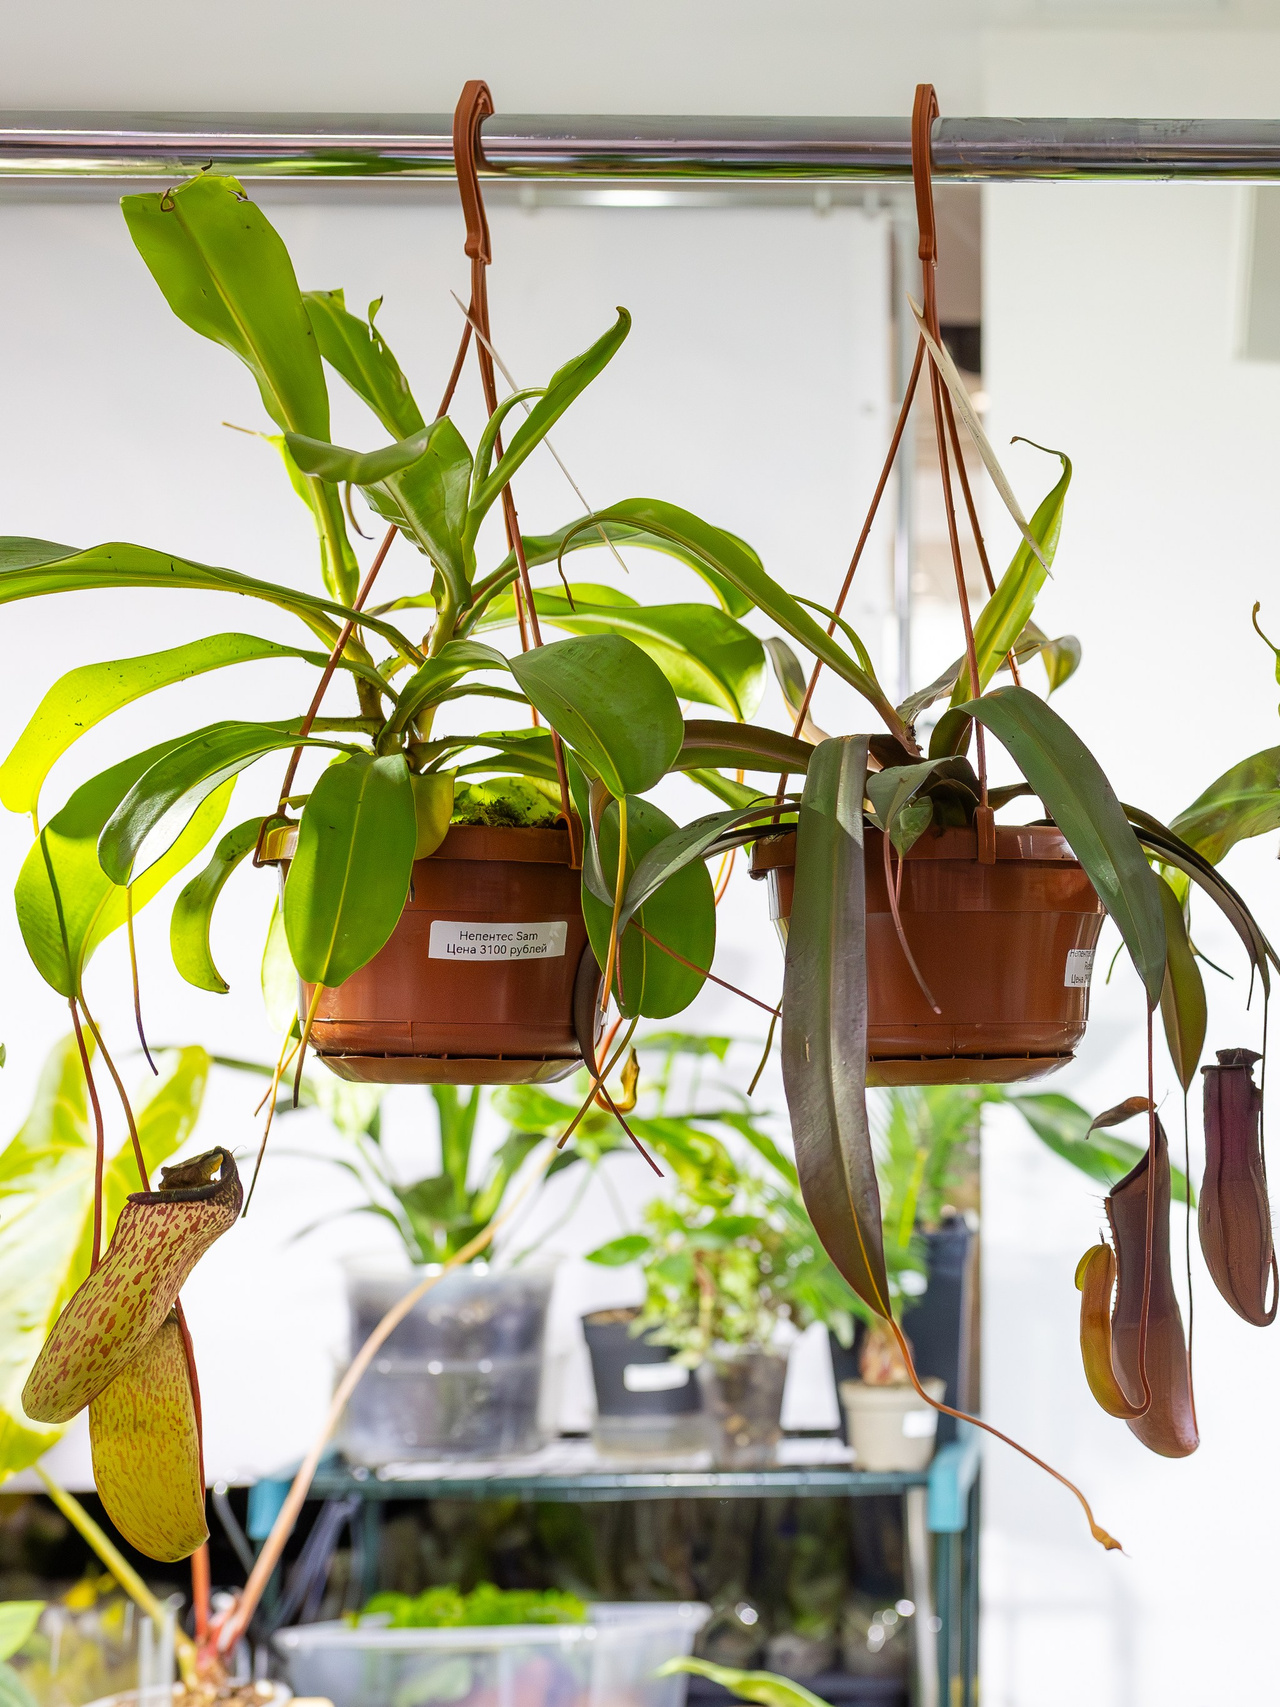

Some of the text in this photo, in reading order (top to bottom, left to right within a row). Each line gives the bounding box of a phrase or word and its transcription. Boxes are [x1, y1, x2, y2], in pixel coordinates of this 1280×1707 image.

[459, 931, 538, 941] Непентес Sam
[446, 943, 547, 957] Цена 3100 рублей
